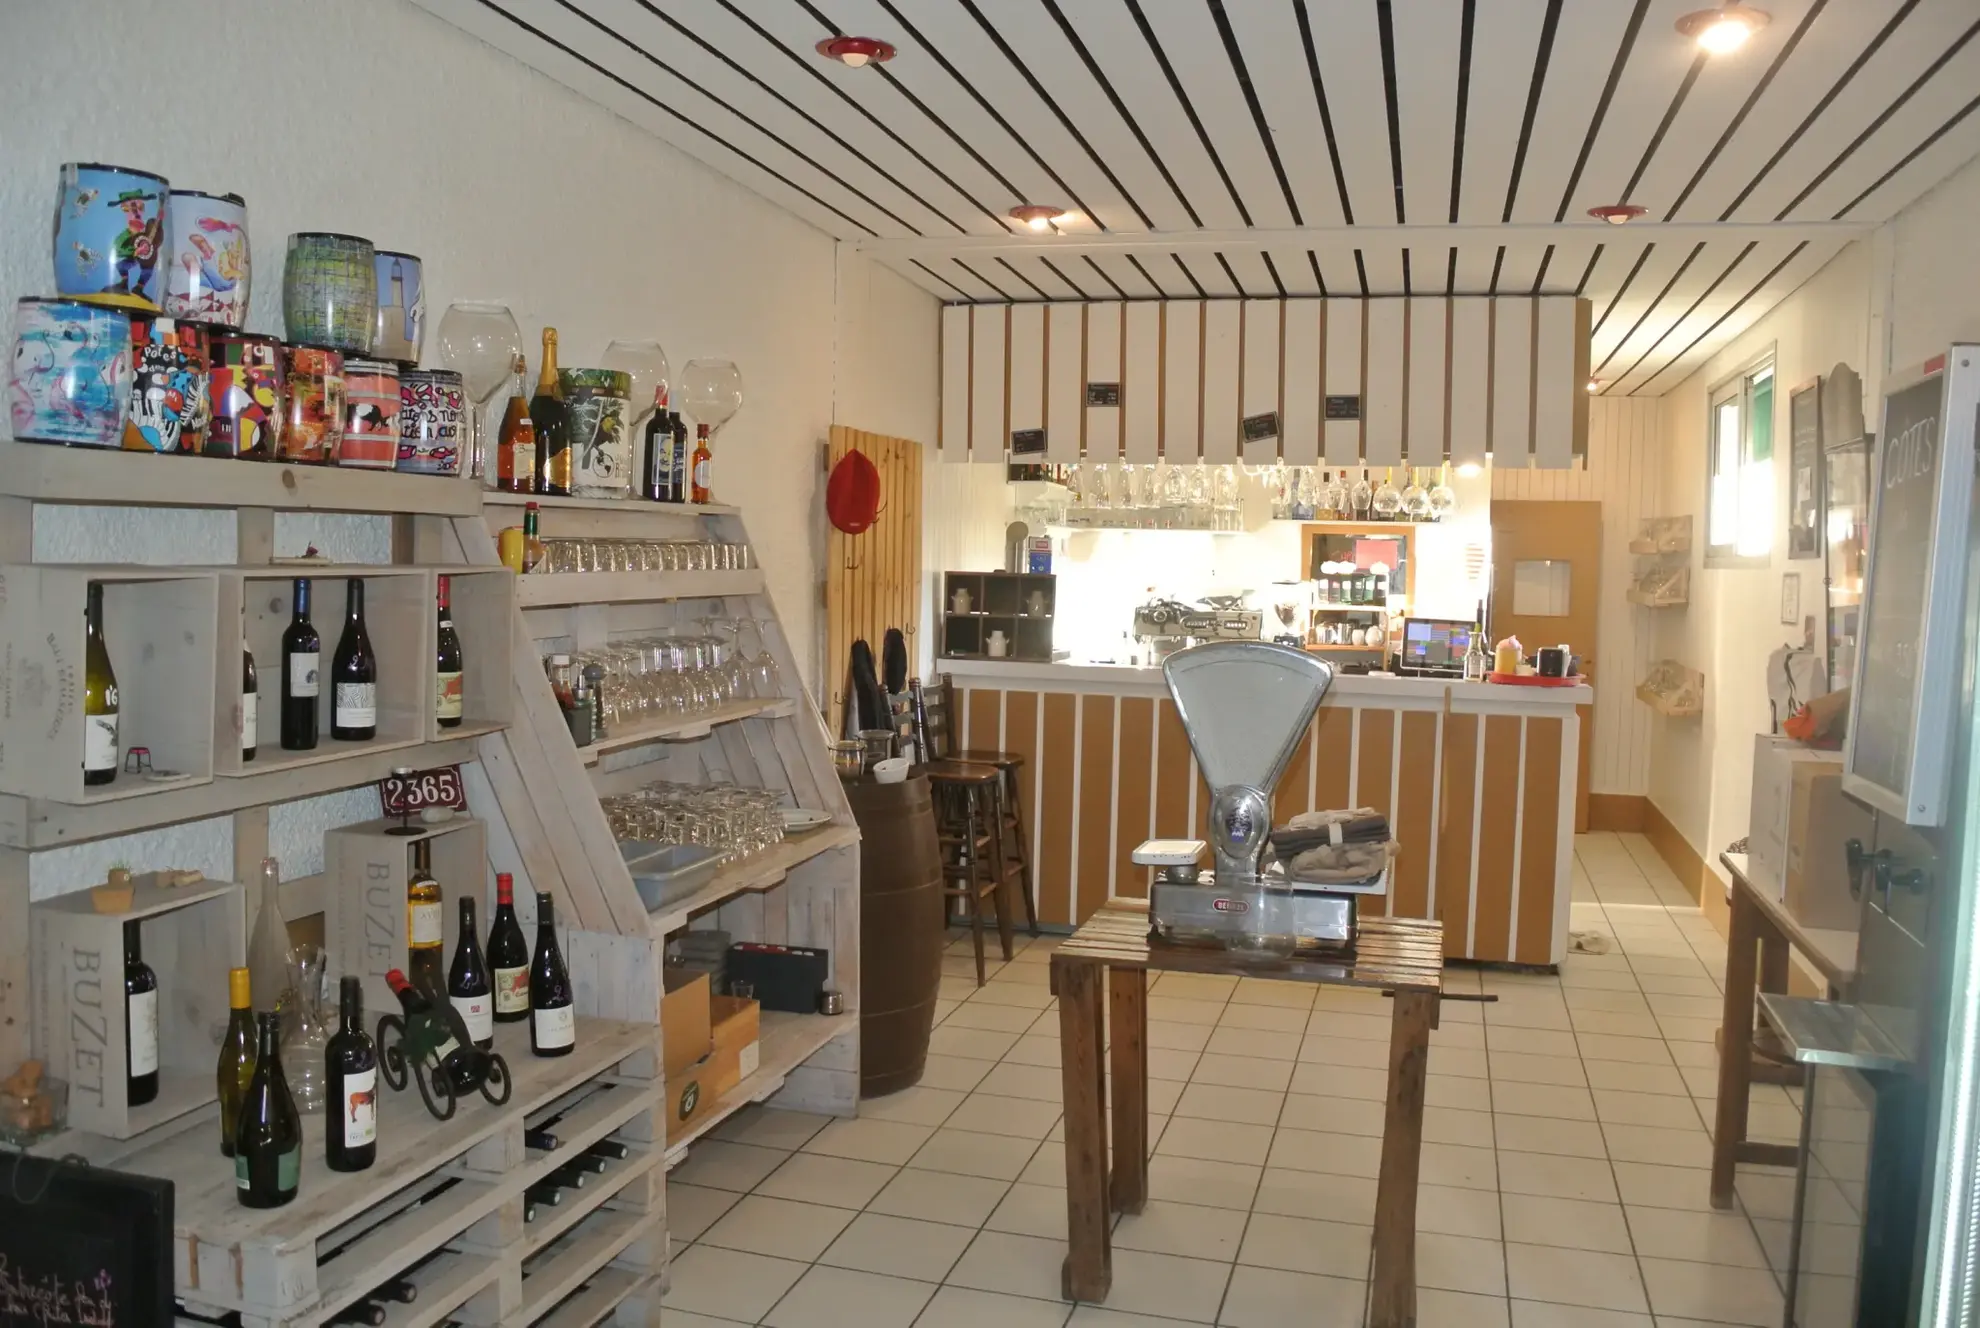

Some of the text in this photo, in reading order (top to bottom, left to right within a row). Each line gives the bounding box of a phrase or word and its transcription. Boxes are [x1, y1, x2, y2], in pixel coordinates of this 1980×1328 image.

[387, 775, 455, 807] 2365
[365, 862, 395, 976] BUZET
[71, 947, 107, 1108] BUZET
